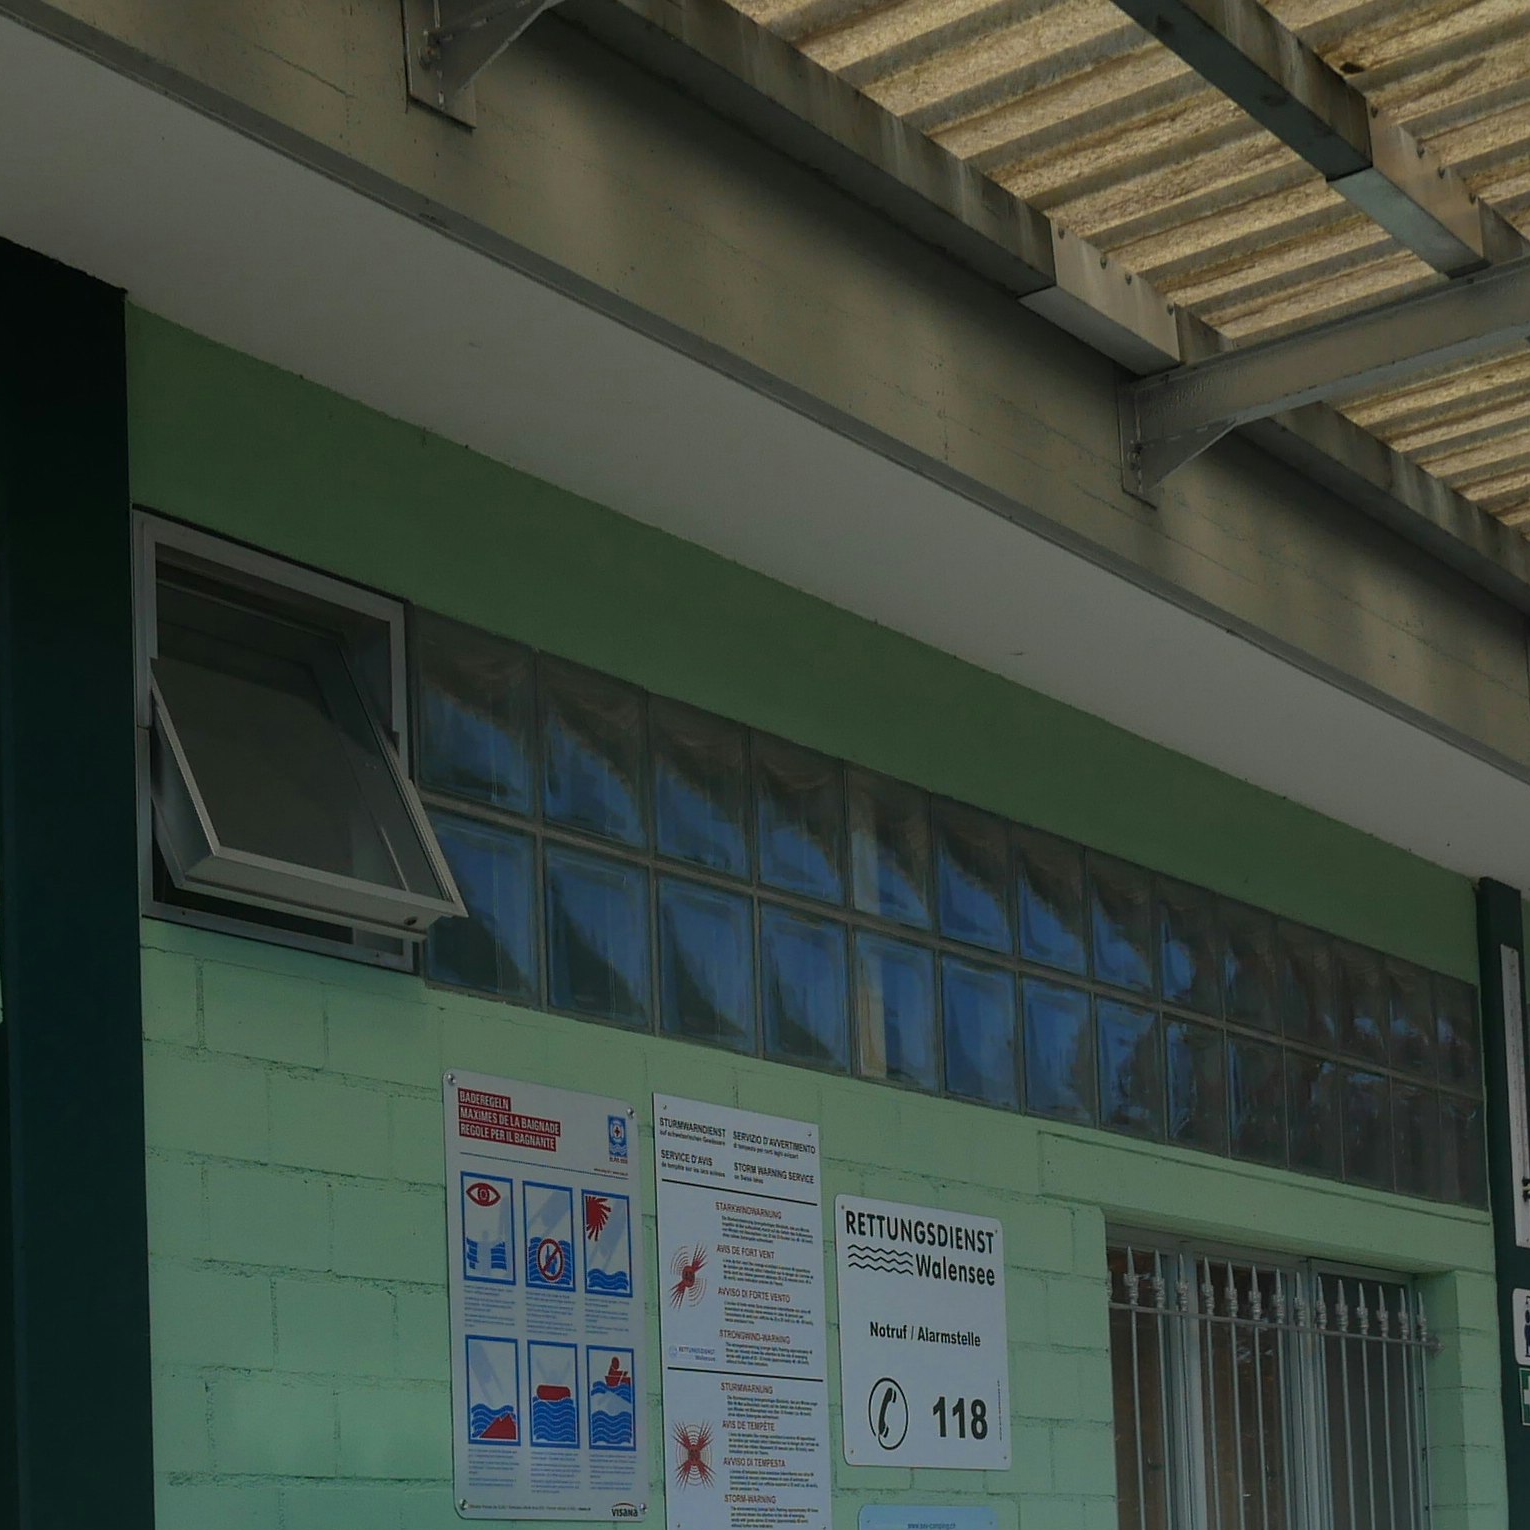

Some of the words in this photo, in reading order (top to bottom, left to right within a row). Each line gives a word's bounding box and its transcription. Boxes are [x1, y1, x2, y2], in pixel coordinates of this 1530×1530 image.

[459, 1090, 510, 1110] BADEREGELN
[460, 1108, 498, 1126] MAXIMES
[499, 1115, 510, 1127] DE
[510, 1116, 520, 1129] LA
[521, 1118, 560, 1135] BAIGNADE
[659, 1117, 726, 1138] STURMWARNDIENST
[460, 1124, 490, 1138] REGOLE
[491, 1129, 505, 1140] PER
[506, 1131, 512, 1141] IL
[515, 1133, 555, 1149] BAGNANTE
[733, 1131, 762, 1144] SERVIZIO
[763, 1135, 816, 1154] D'AVVERTIMENTO
[661, 1149, 690, 1163] SERVICE
[691, 1153, 713, 1166] D'AVIS
[734, 1162, 757, 1174] STORM
[758, 1166, 787, 1180] WARNING
[788, 1171, 814, 1184] SERVICE
[846, 1210, 994, 1254] RETTUNGSDIENST
[716, 1244, 730, 1254] AVIS
[732, 1246, 740, 1255] DE
[741, 1247, 758, 1257] FORT
[758, 1249, 775, 1259] VENT
[916, 1253, 995, 1286] Walensee
[718, 1287, 740, 1297] AVVISO
[742, 1288, 748, 1298] DI
[749, 1290, 769, 1301] FORTE
[770, 1292, 790, 1303] VENTO
[870, 1321, 907, 1339] Notruf
[910, 1325, 915, 1340] /
[917, 1326, 981, 1347] Alarmstelle
[721, 1382, 773, 1394] STURMWARNUNG
[722, 1420, 736, 1429] AVIS
[737, 1421, 746, 1430] DE
[932, 1395, 988, 1440] 118
[723, 1457, 746, 1466] AVVISO
[747, 1458, 754, 1466] DI
[754, 1458, 786, 1468] TEMPESTA
[725, 1494, 777, 1504] STORM-WARNING
